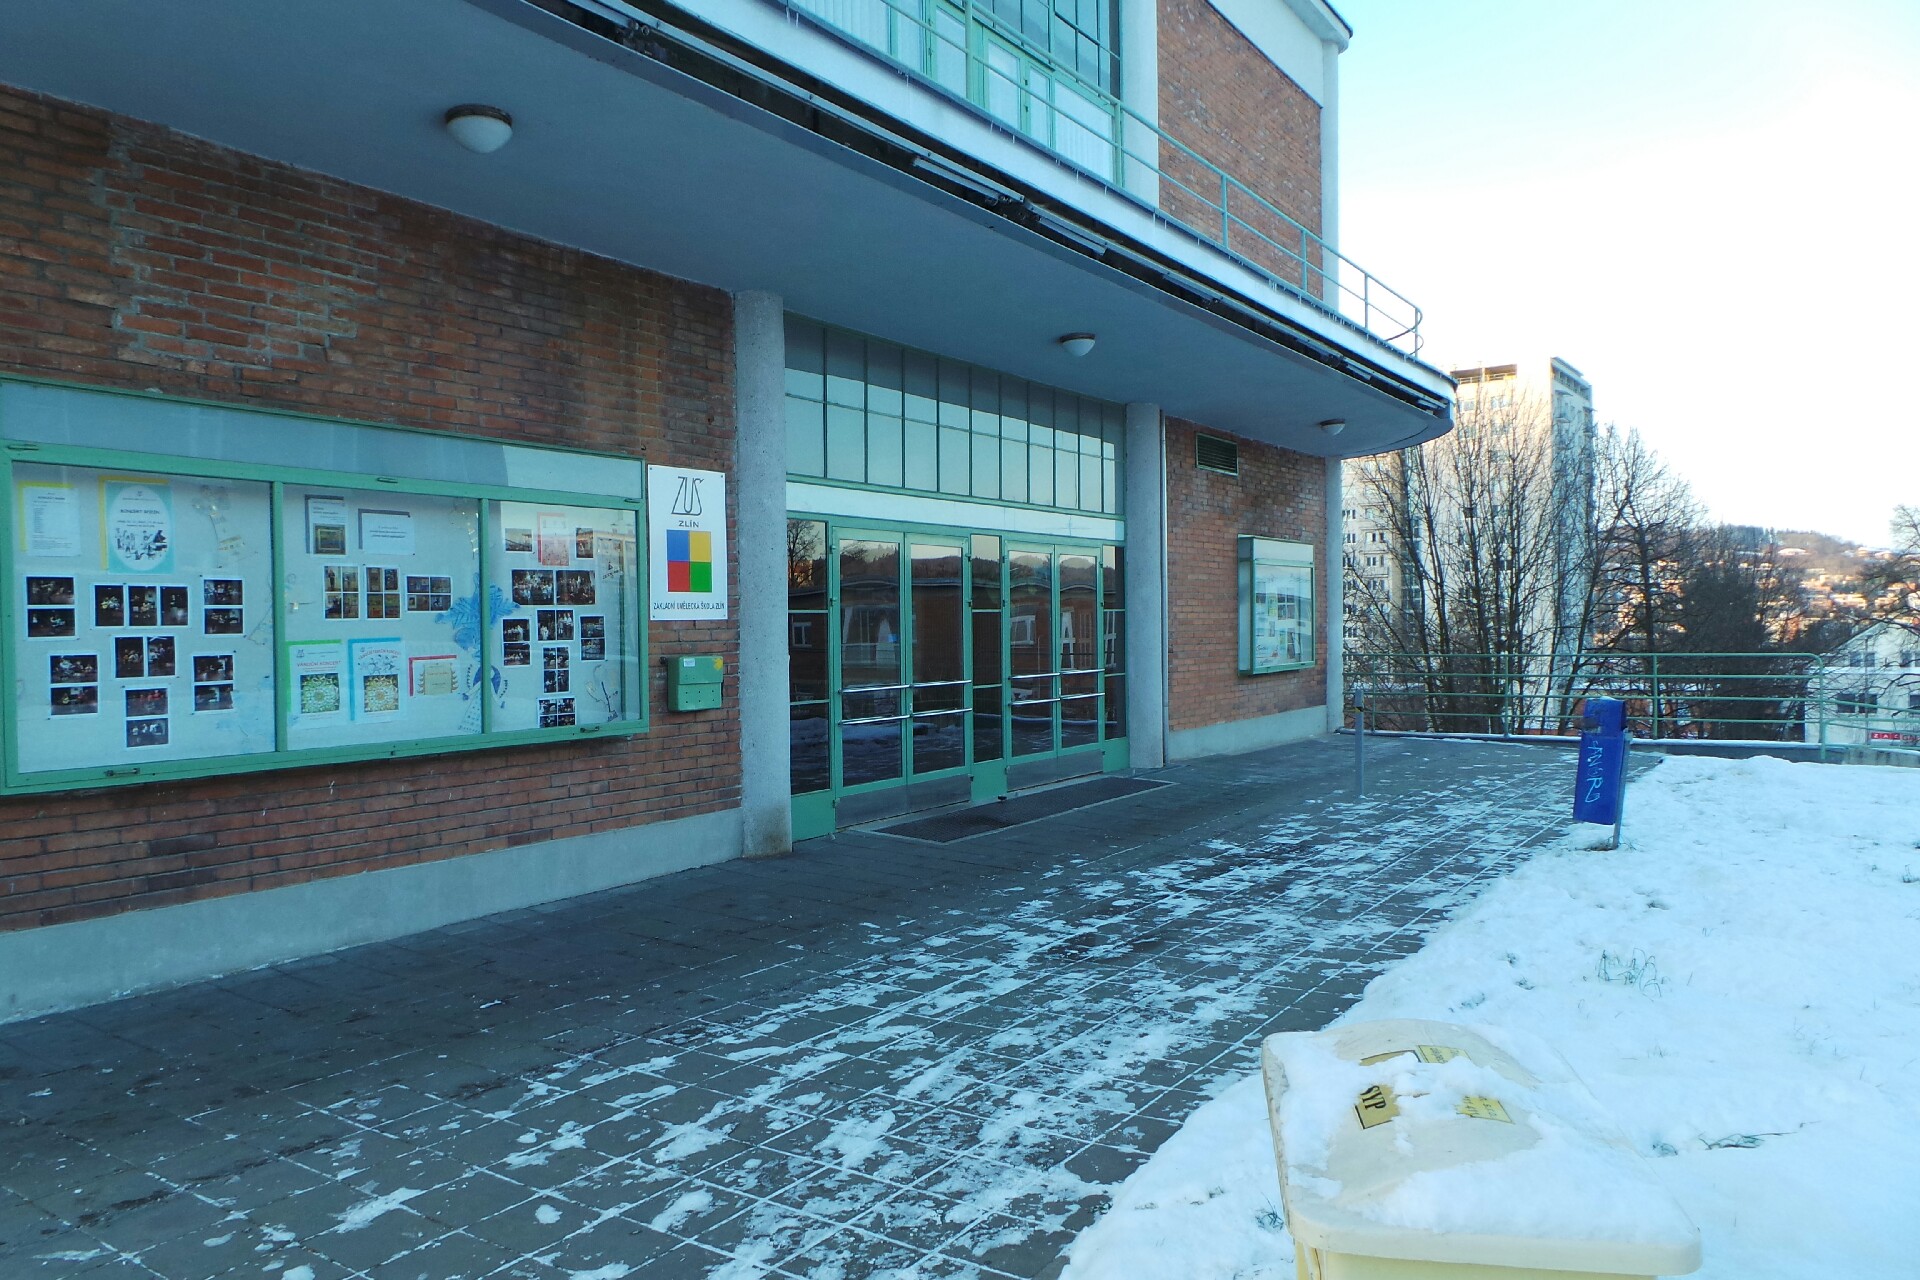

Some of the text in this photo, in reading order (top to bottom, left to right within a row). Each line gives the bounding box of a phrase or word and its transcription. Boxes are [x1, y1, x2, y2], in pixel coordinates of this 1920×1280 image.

[678, 519, 700, 528] ZLÍN
[700, 601, 715, 610] ŠKOLA
[715, 602, 725, 610] ZLÍN
